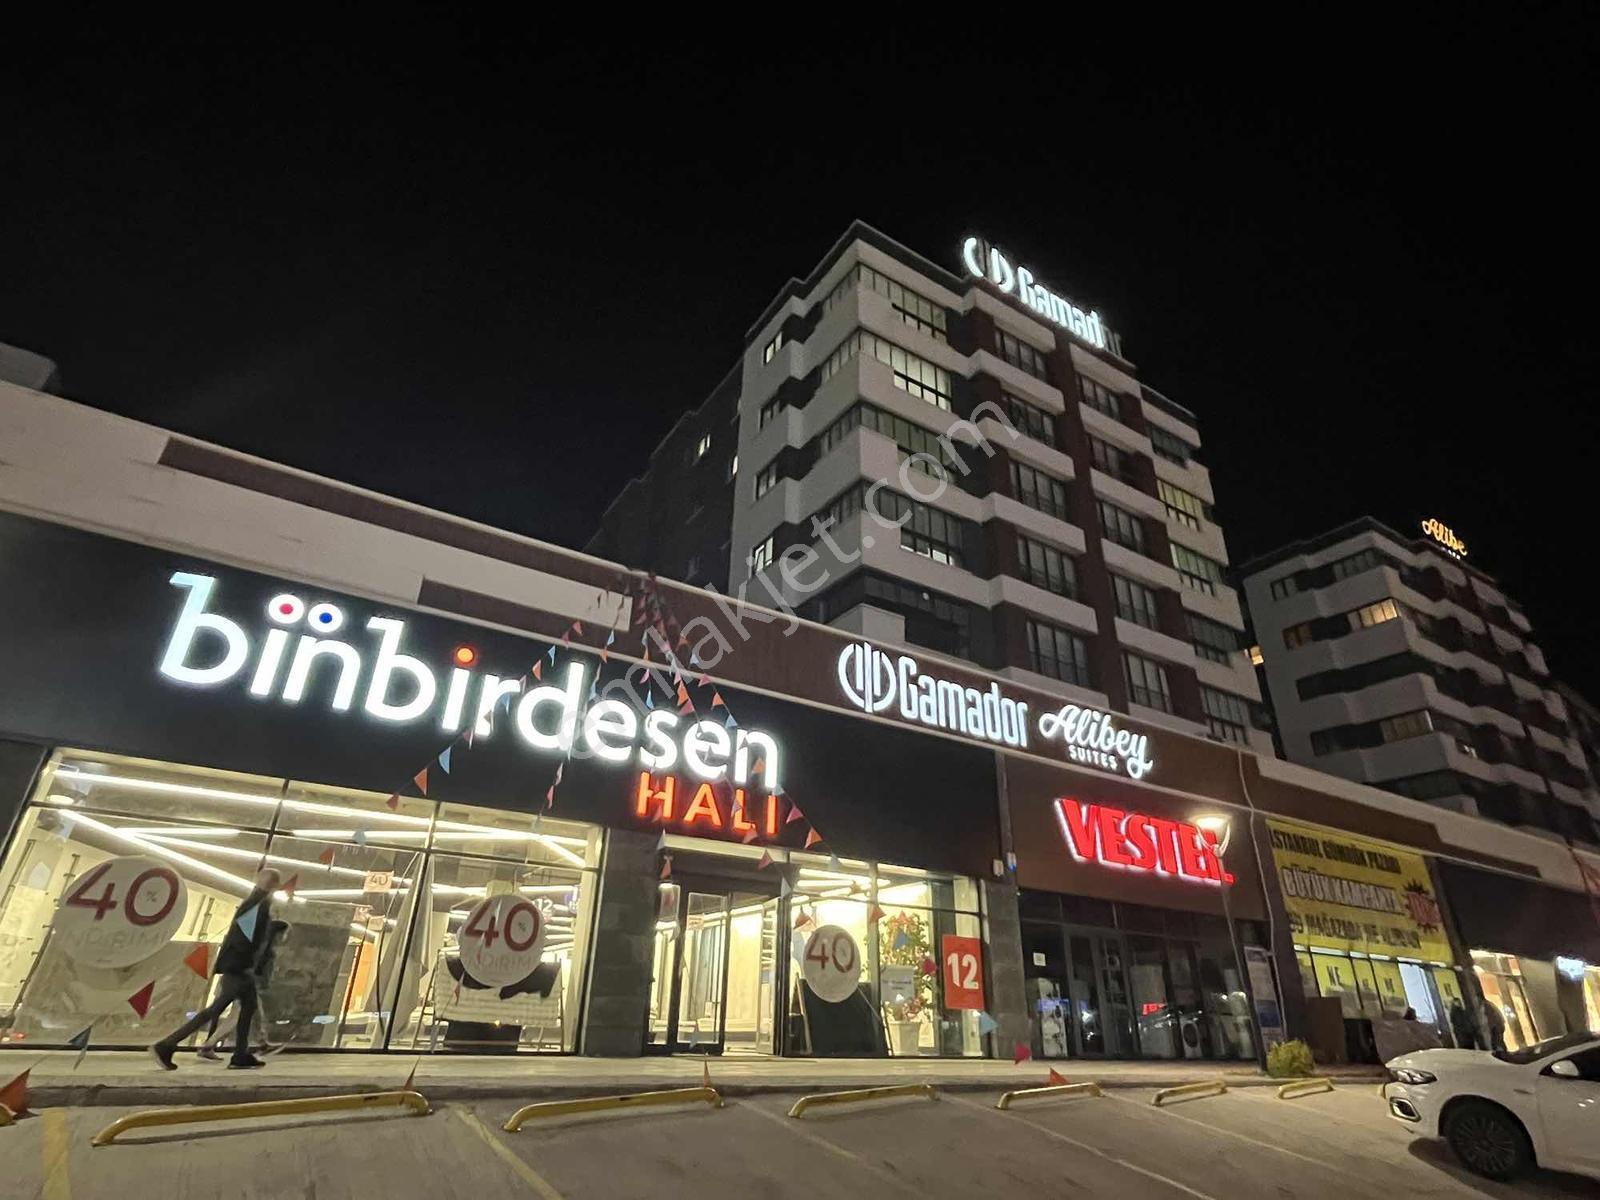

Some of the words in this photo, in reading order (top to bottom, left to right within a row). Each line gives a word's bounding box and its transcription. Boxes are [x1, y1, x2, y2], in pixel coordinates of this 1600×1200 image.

[160, 572, 779, 788] binbirdesen
[898, 656, 1028, 748] Gamador
[1038, 704, 1153, 779] Alibey
[1068, 745, 1117, 770] SUITES
[637, 770, 778, 834] HALI
[1055, 797, 1235, 886] VESTEL
[66, 863, 180, 926] 40
[465, 900, 540, 951] 40
[805, 931, 856, 973] 40
[947, 951, 979, 991] 12
